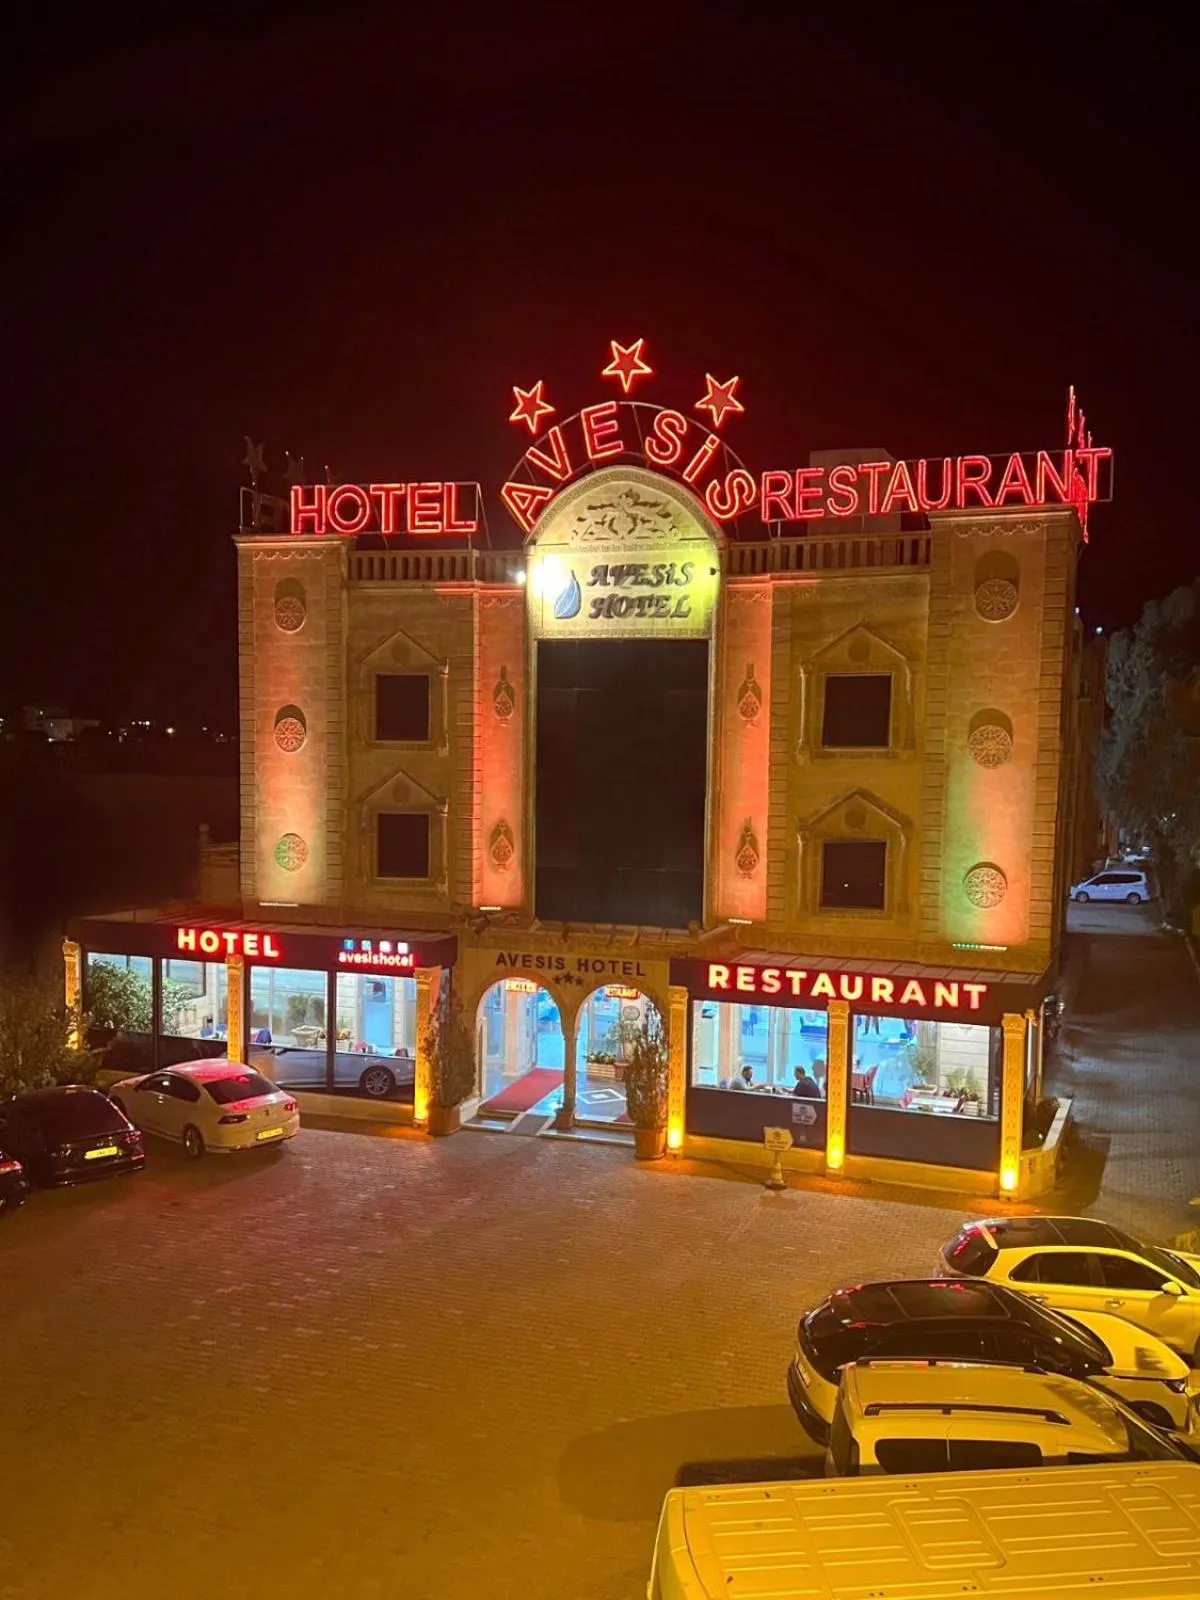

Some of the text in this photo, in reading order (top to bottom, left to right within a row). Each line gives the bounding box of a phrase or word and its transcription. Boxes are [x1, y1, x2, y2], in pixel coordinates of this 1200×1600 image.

[760, 447, 1112, 522] RESTAURANT
[290, 482, 478, 535] HOTEL
[588, 592, 692, 619] HOTEL
[177, 928, 279, 958] HOTEL
[496, 952, 646, 977] AVESIS HOTEL
[707, 963, 988, 1010] RESTAURANT
